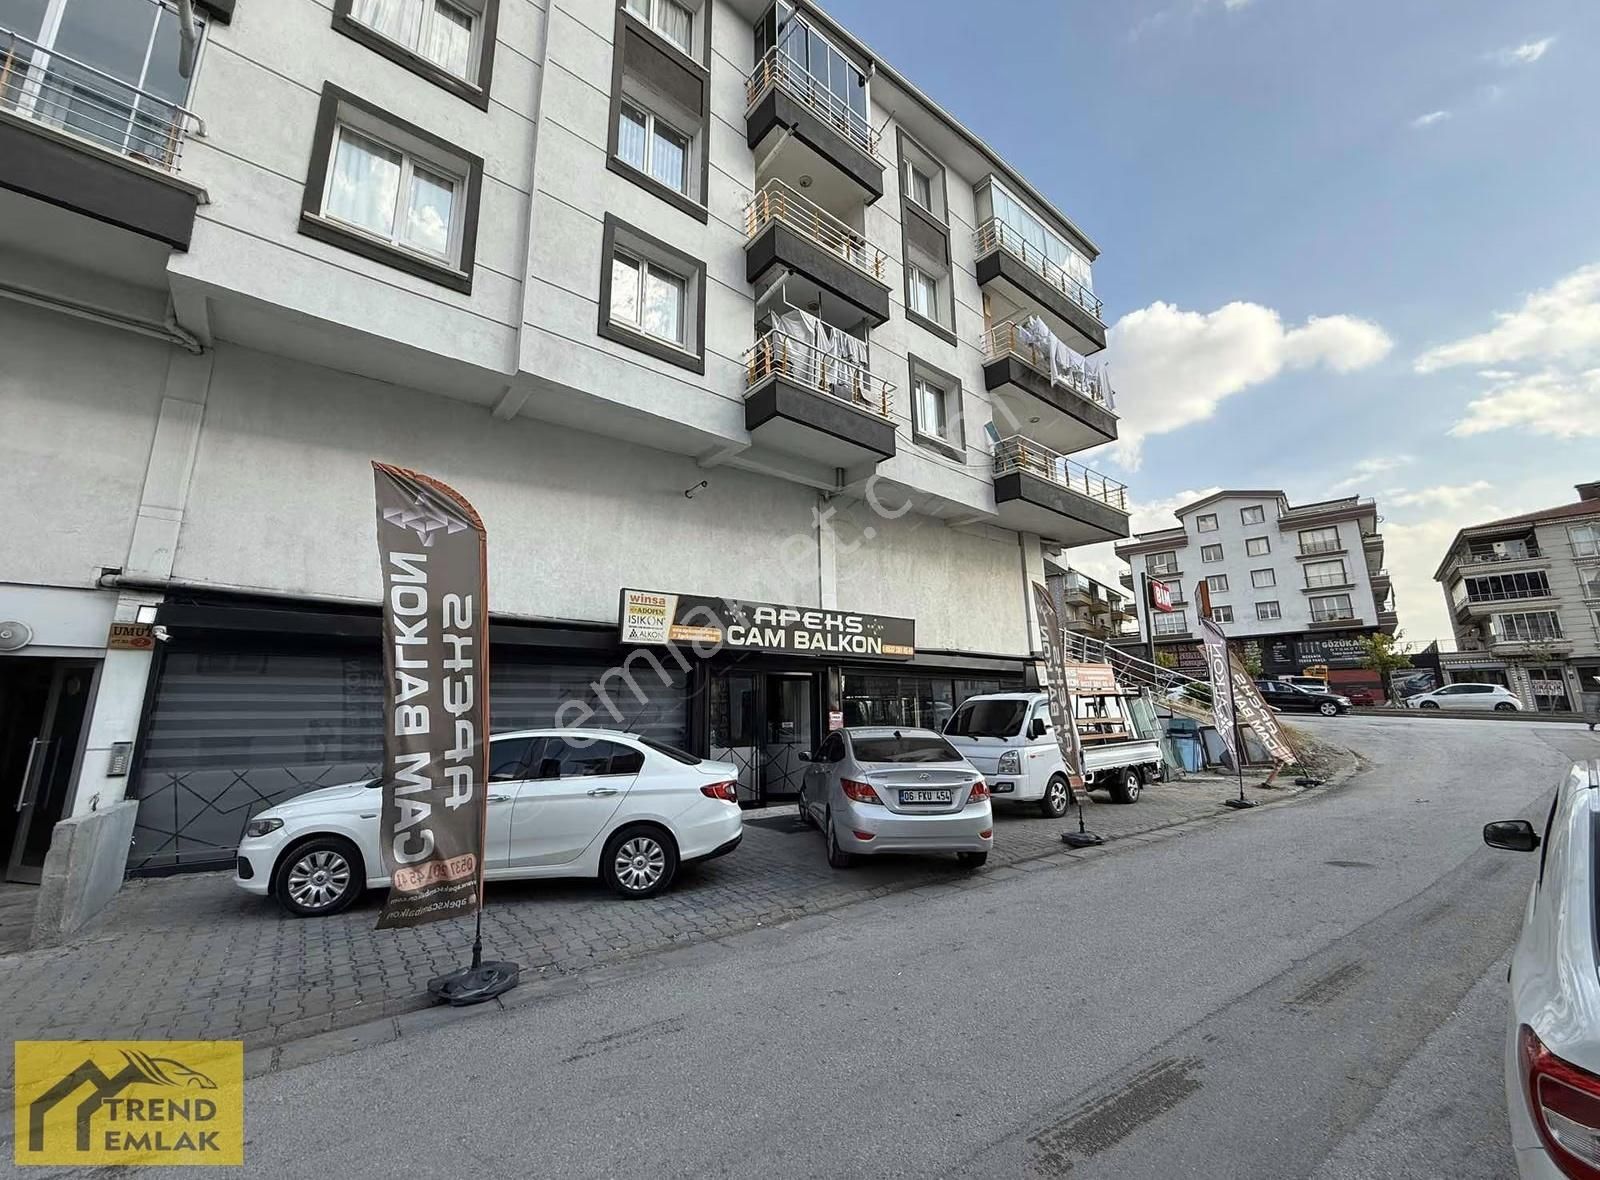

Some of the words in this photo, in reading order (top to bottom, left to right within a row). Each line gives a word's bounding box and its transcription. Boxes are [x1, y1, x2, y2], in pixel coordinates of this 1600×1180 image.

[629, 593, 666, 605] winsa
[753, 606, 863, 633] APEKS
[727, 625, 785, 648] CAM
[794, 630, 882, 655] BALKON
[904, 791, 914, 801] 06
[936, 791, 950, 801] 454
